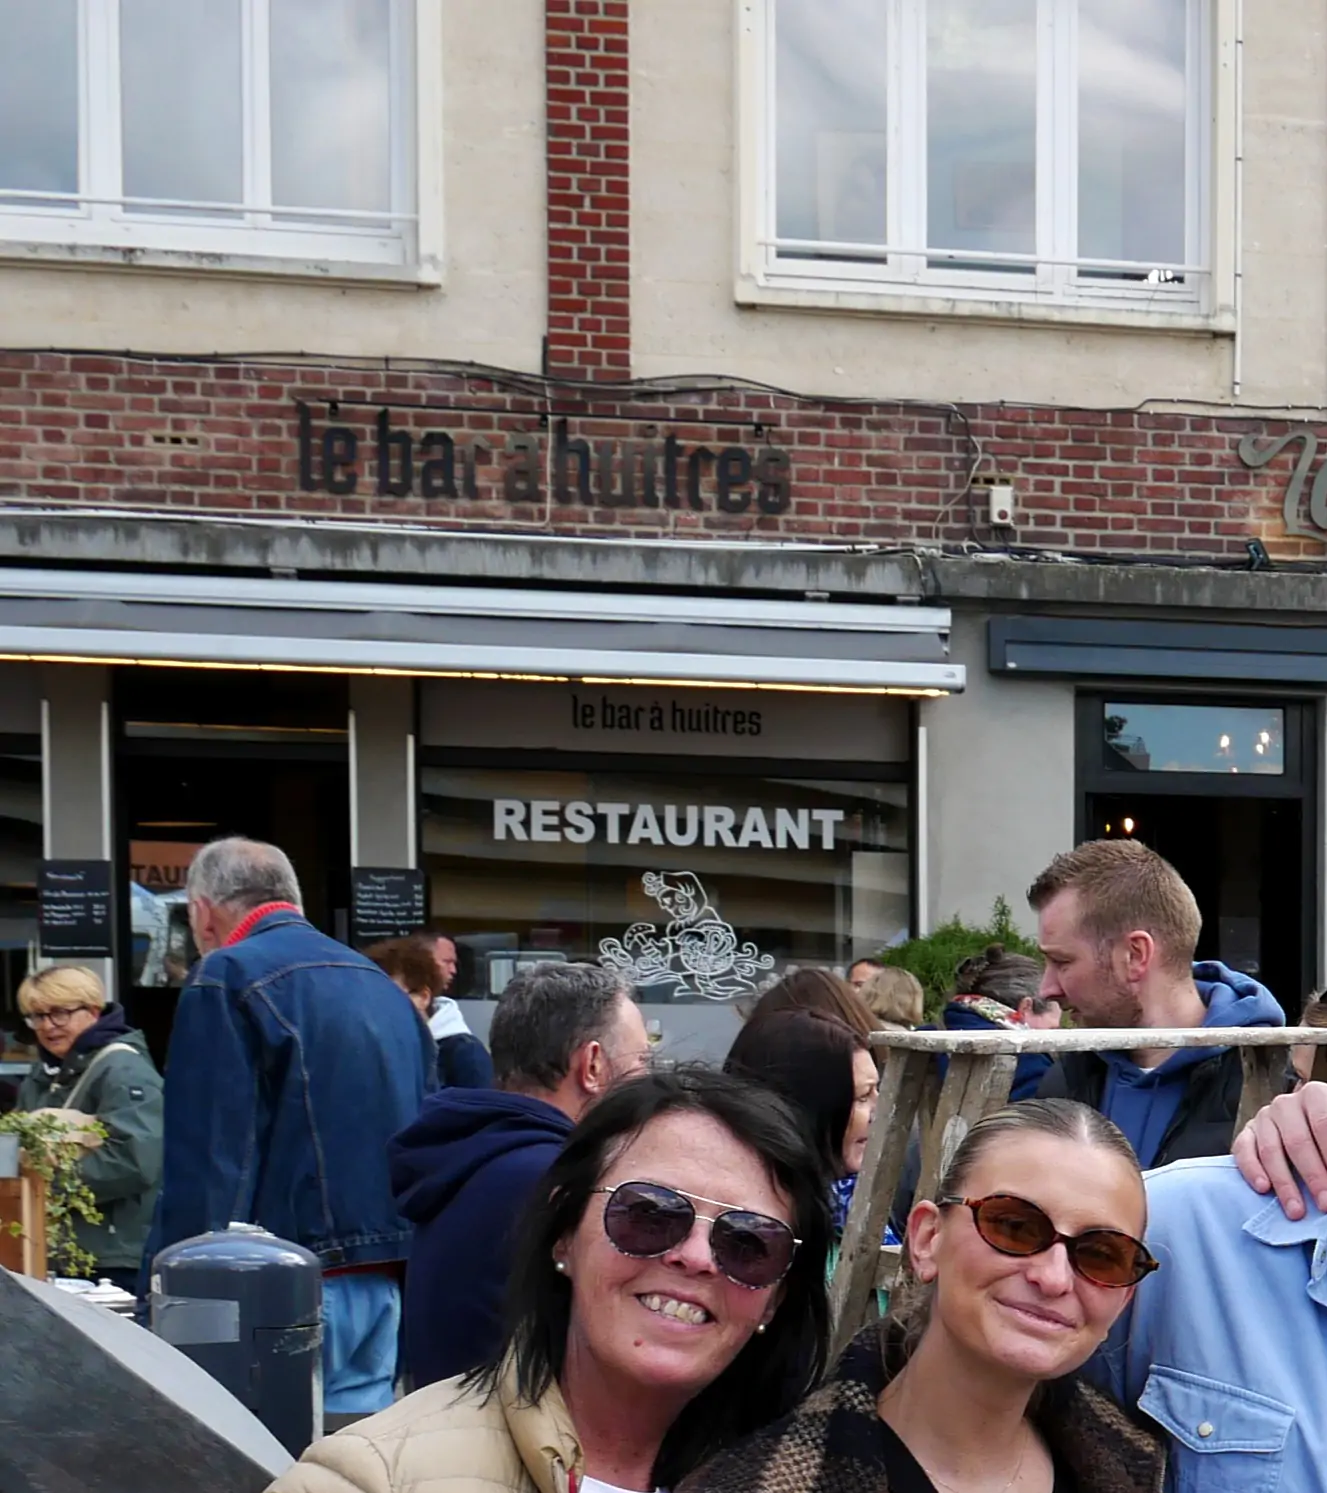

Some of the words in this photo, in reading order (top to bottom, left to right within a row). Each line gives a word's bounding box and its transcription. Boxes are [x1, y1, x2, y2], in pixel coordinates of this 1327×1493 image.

[295, 400, 358, 496] le
[377, 407, 492, 499] bar
[571, 694, 596, 730] le
[601, 695, 646, 732] bar
[650, 700, 664, 732] à
[493, 799, 845, 850] RESTAURANT
